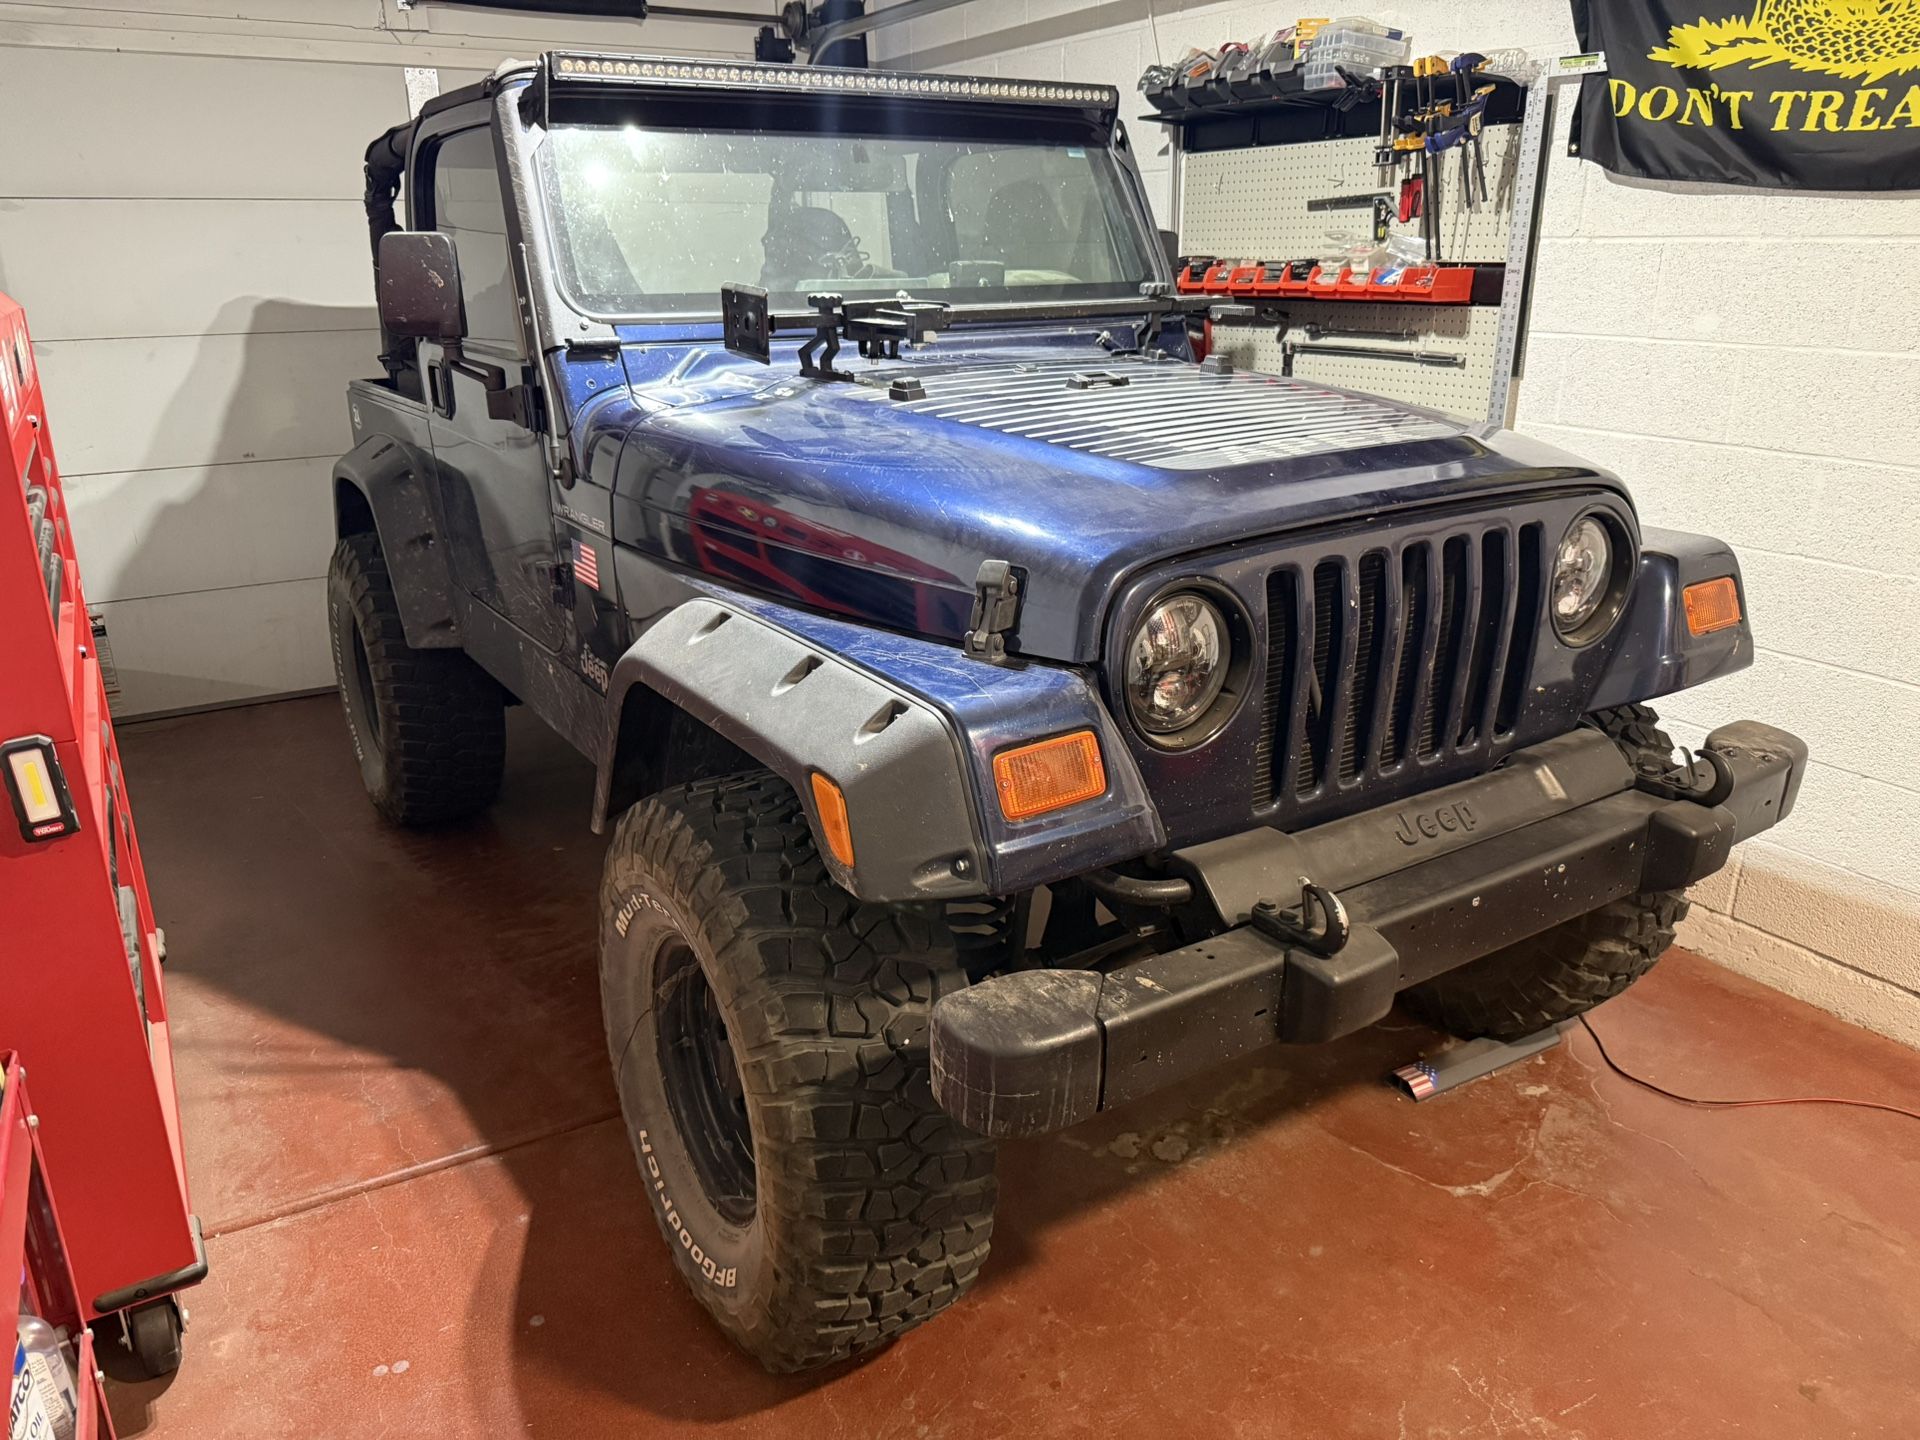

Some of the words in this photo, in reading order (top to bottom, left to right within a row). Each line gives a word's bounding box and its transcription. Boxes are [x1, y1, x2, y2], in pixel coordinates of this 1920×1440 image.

[1608, 79, 1753, 130] DON'T
[1770, 84, 1920, 132] TREA
[555, 502, 606, 533] WRANGLER
[580, 648, 609, 693] Jeep
[1394, 801, 1477, 846] Jeep
[639, 1129, 737, 1288] BFGoodrich
